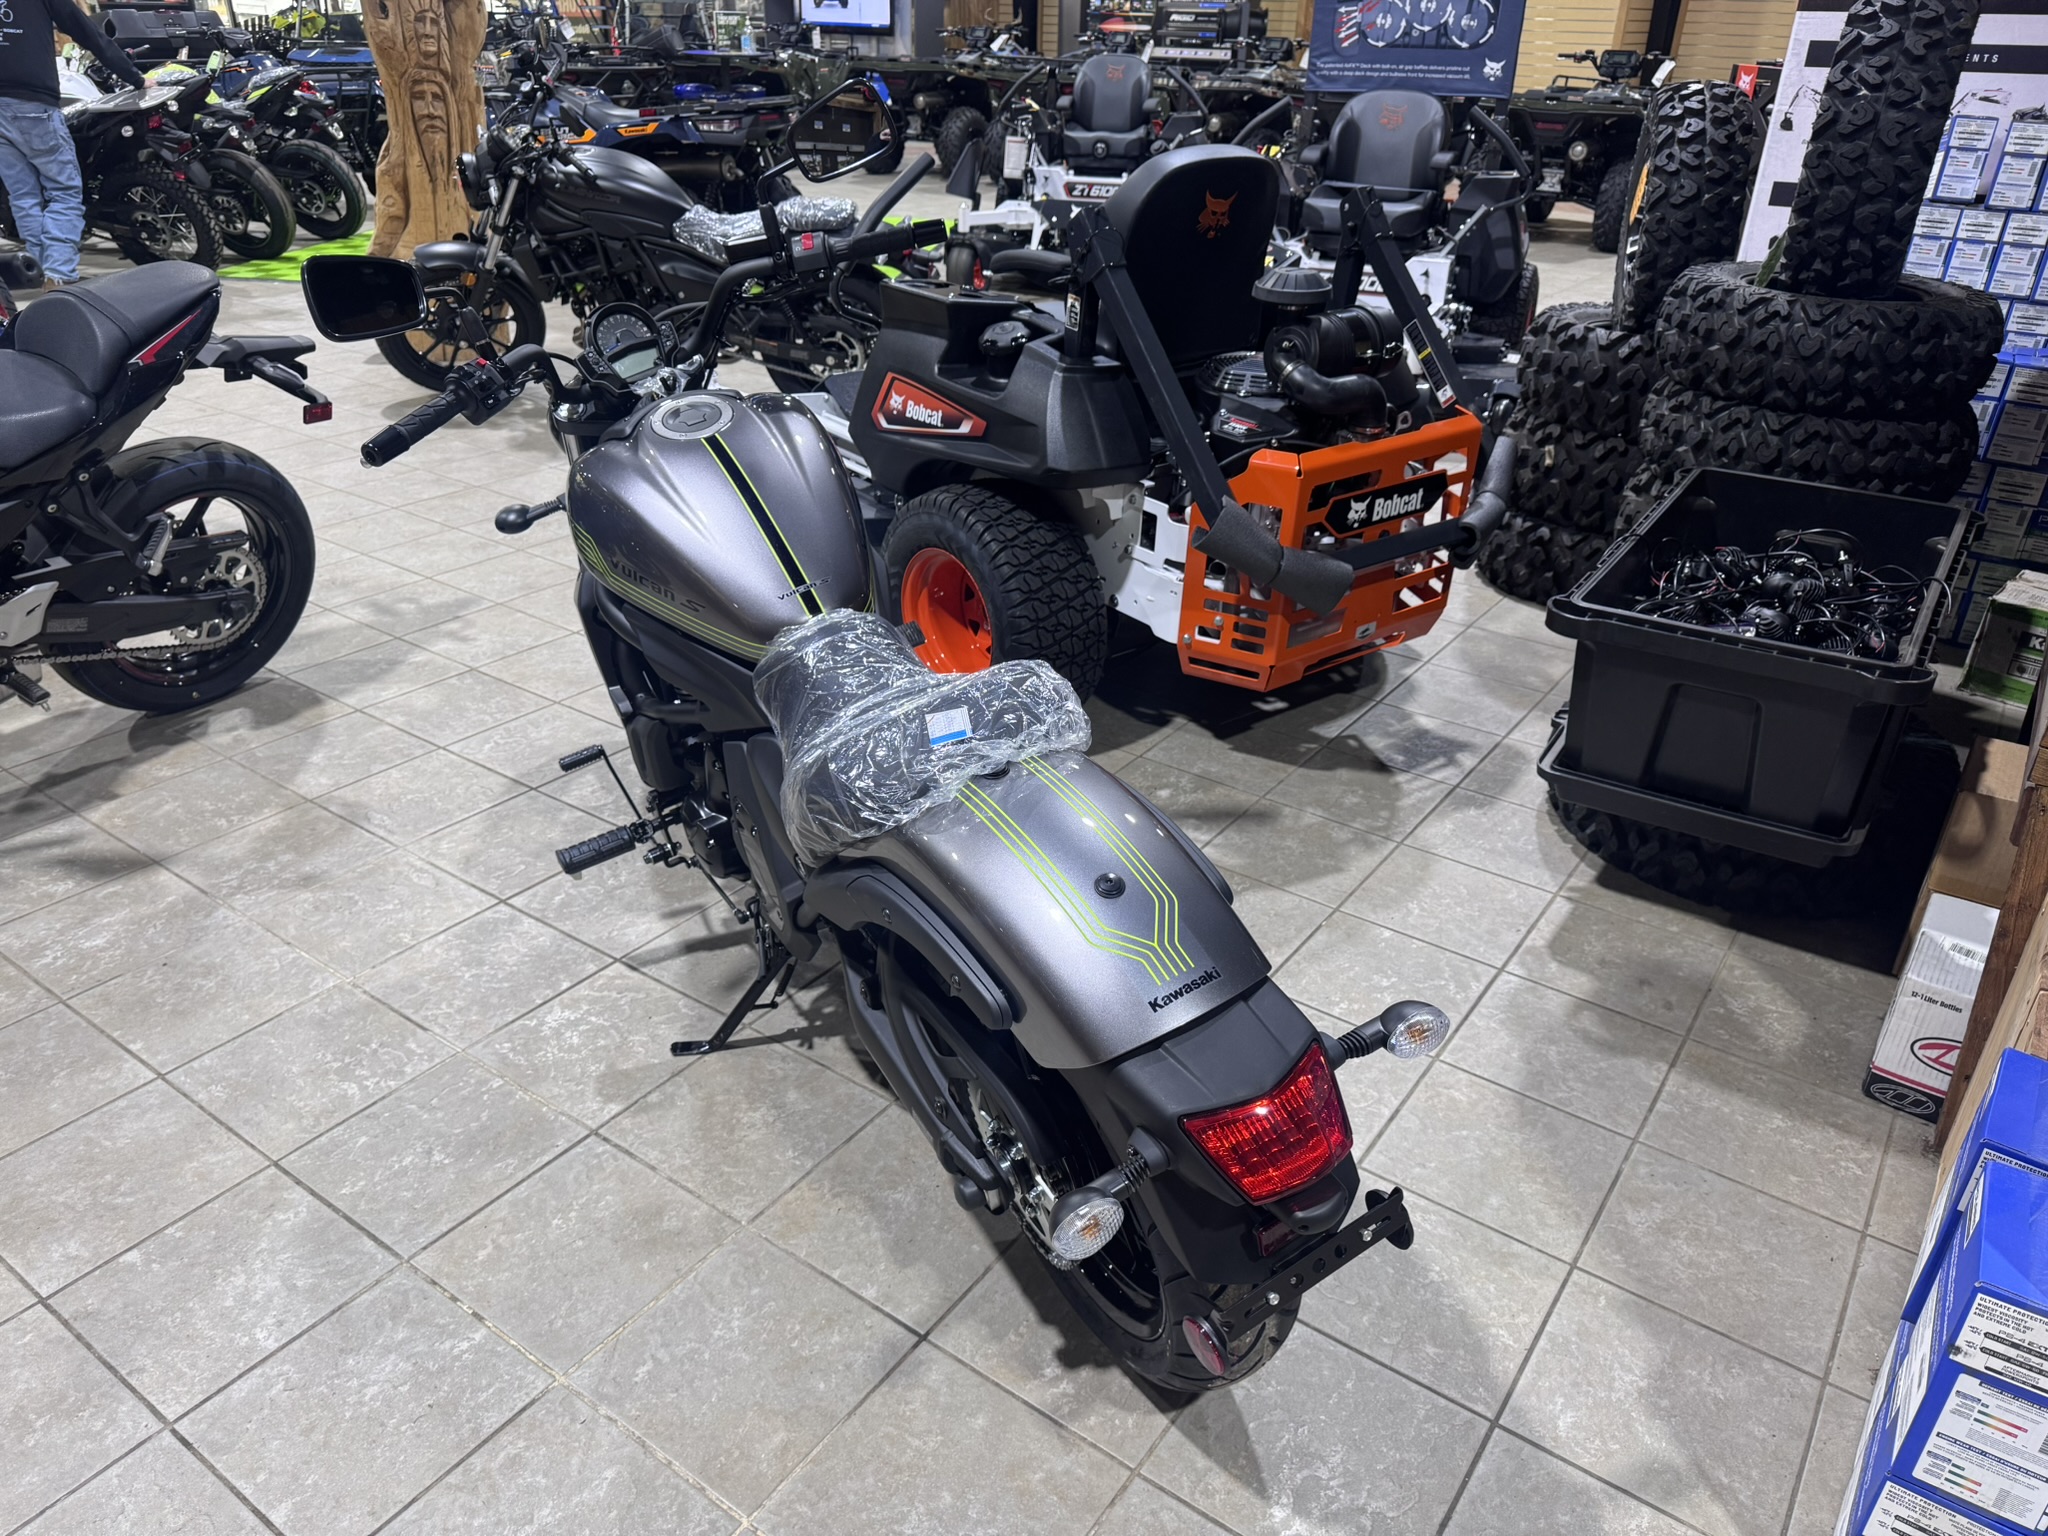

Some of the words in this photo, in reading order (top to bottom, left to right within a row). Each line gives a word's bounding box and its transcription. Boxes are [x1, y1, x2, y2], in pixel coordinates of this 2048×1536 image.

[905, 400, 943, 428] Bobcat
[1372, 487, 1424, 522] Bobcat
[1147, 966, 1222, 1013] Kawasaki
[1924, 995, 1939, 1005] Liter
[1940, 1000, 1963, 1013] Bottles
[1985, 1151, 2014, 1165] ULTIMATE
[2014, 1162, 2048, 1178] PROTECTIO
[1977, 1303, 1998, 1313] WIDEST
[1999, 1310, 2028, 1324] VISCOSITY
[1979, 1296, 2012, 1312] ULTIMATE
[1975, 1307, 2004, 1320] PROTECTS
[2010, 1319, 2022, 1327] THE
[2022, 1324, 2034, 1332] HOT
[1985, 1316, 2011, 1328] EXTREME
[2011, 1325, 2027, 1334] COLD
[1886, 1492, 1911, 1506] PROTECTS
[1890, 1484, 1919, 1500] ULTIMATE
[1919, 1499, 1957, 1518] PROTECTION
